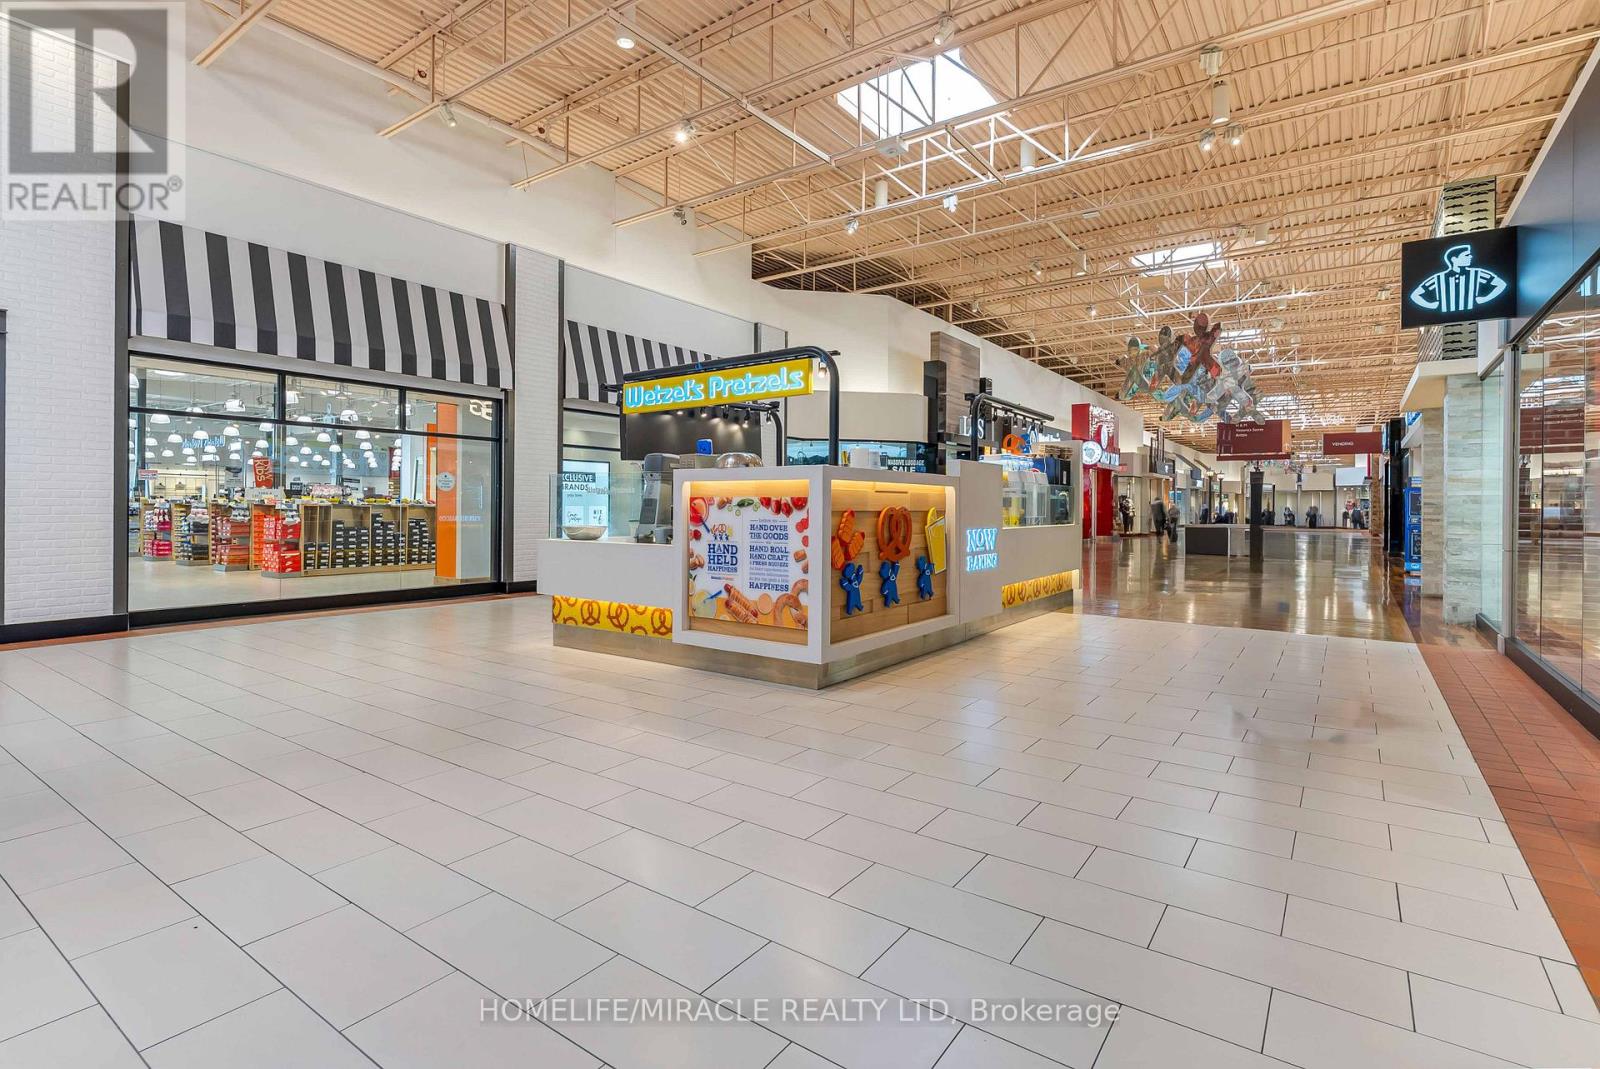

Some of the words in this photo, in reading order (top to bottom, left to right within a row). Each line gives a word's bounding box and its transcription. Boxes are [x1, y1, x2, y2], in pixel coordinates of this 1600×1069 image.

[625, 378, 704, 408] Wetzel's
[708, 367, 804, 398] Pretzels
[254, 460, 265, 481] KIDS
[563, 473, 593, 482] CLUSIVE
[565, 483, 589, 491] RANDS
[769, 524, 788, 532] OVER
[763, 532, 789, 540] GOODS
[966, 528, 998, 552] NOW
[708, 543, 738, 555] HAND
[708, 554, 738, 566] HELD
[749, 552, 766, 560] HAND
[966, 553, 998, 571] BAKING
[749, 582, 789, 592] HAPPINESS
